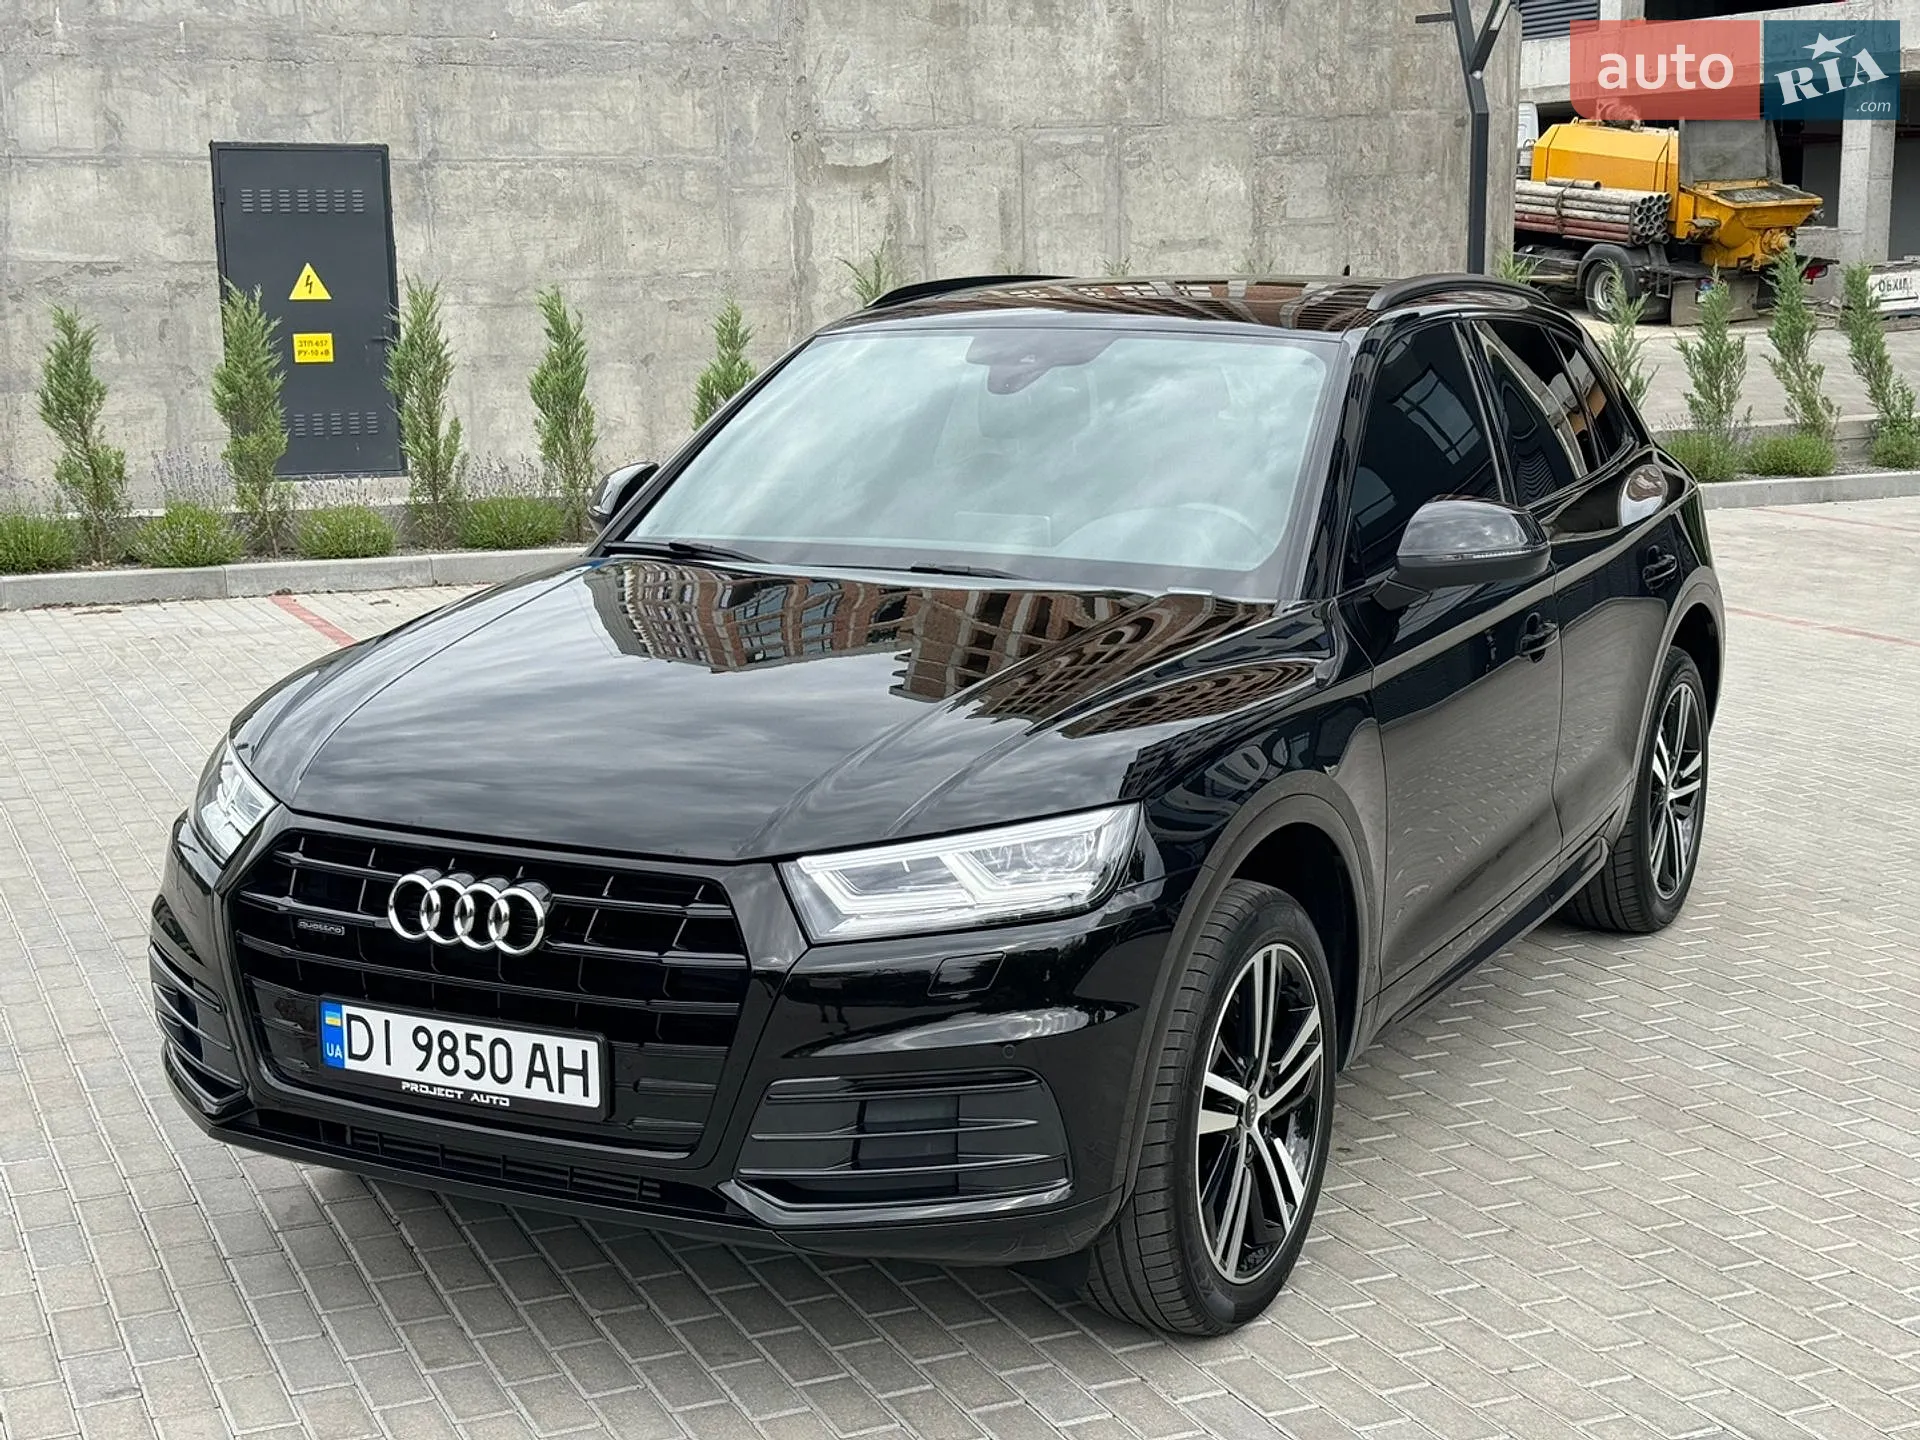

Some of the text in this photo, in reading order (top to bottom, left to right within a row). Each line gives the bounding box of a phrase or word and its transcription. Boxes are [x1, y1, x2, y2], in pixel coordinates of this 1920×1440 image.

[326, 1042, 343, 1059] UA
[346, 1013, 590, 1099] DI 9850 AH
[401, 1081, 511, 1107] PROJECT AUTO
